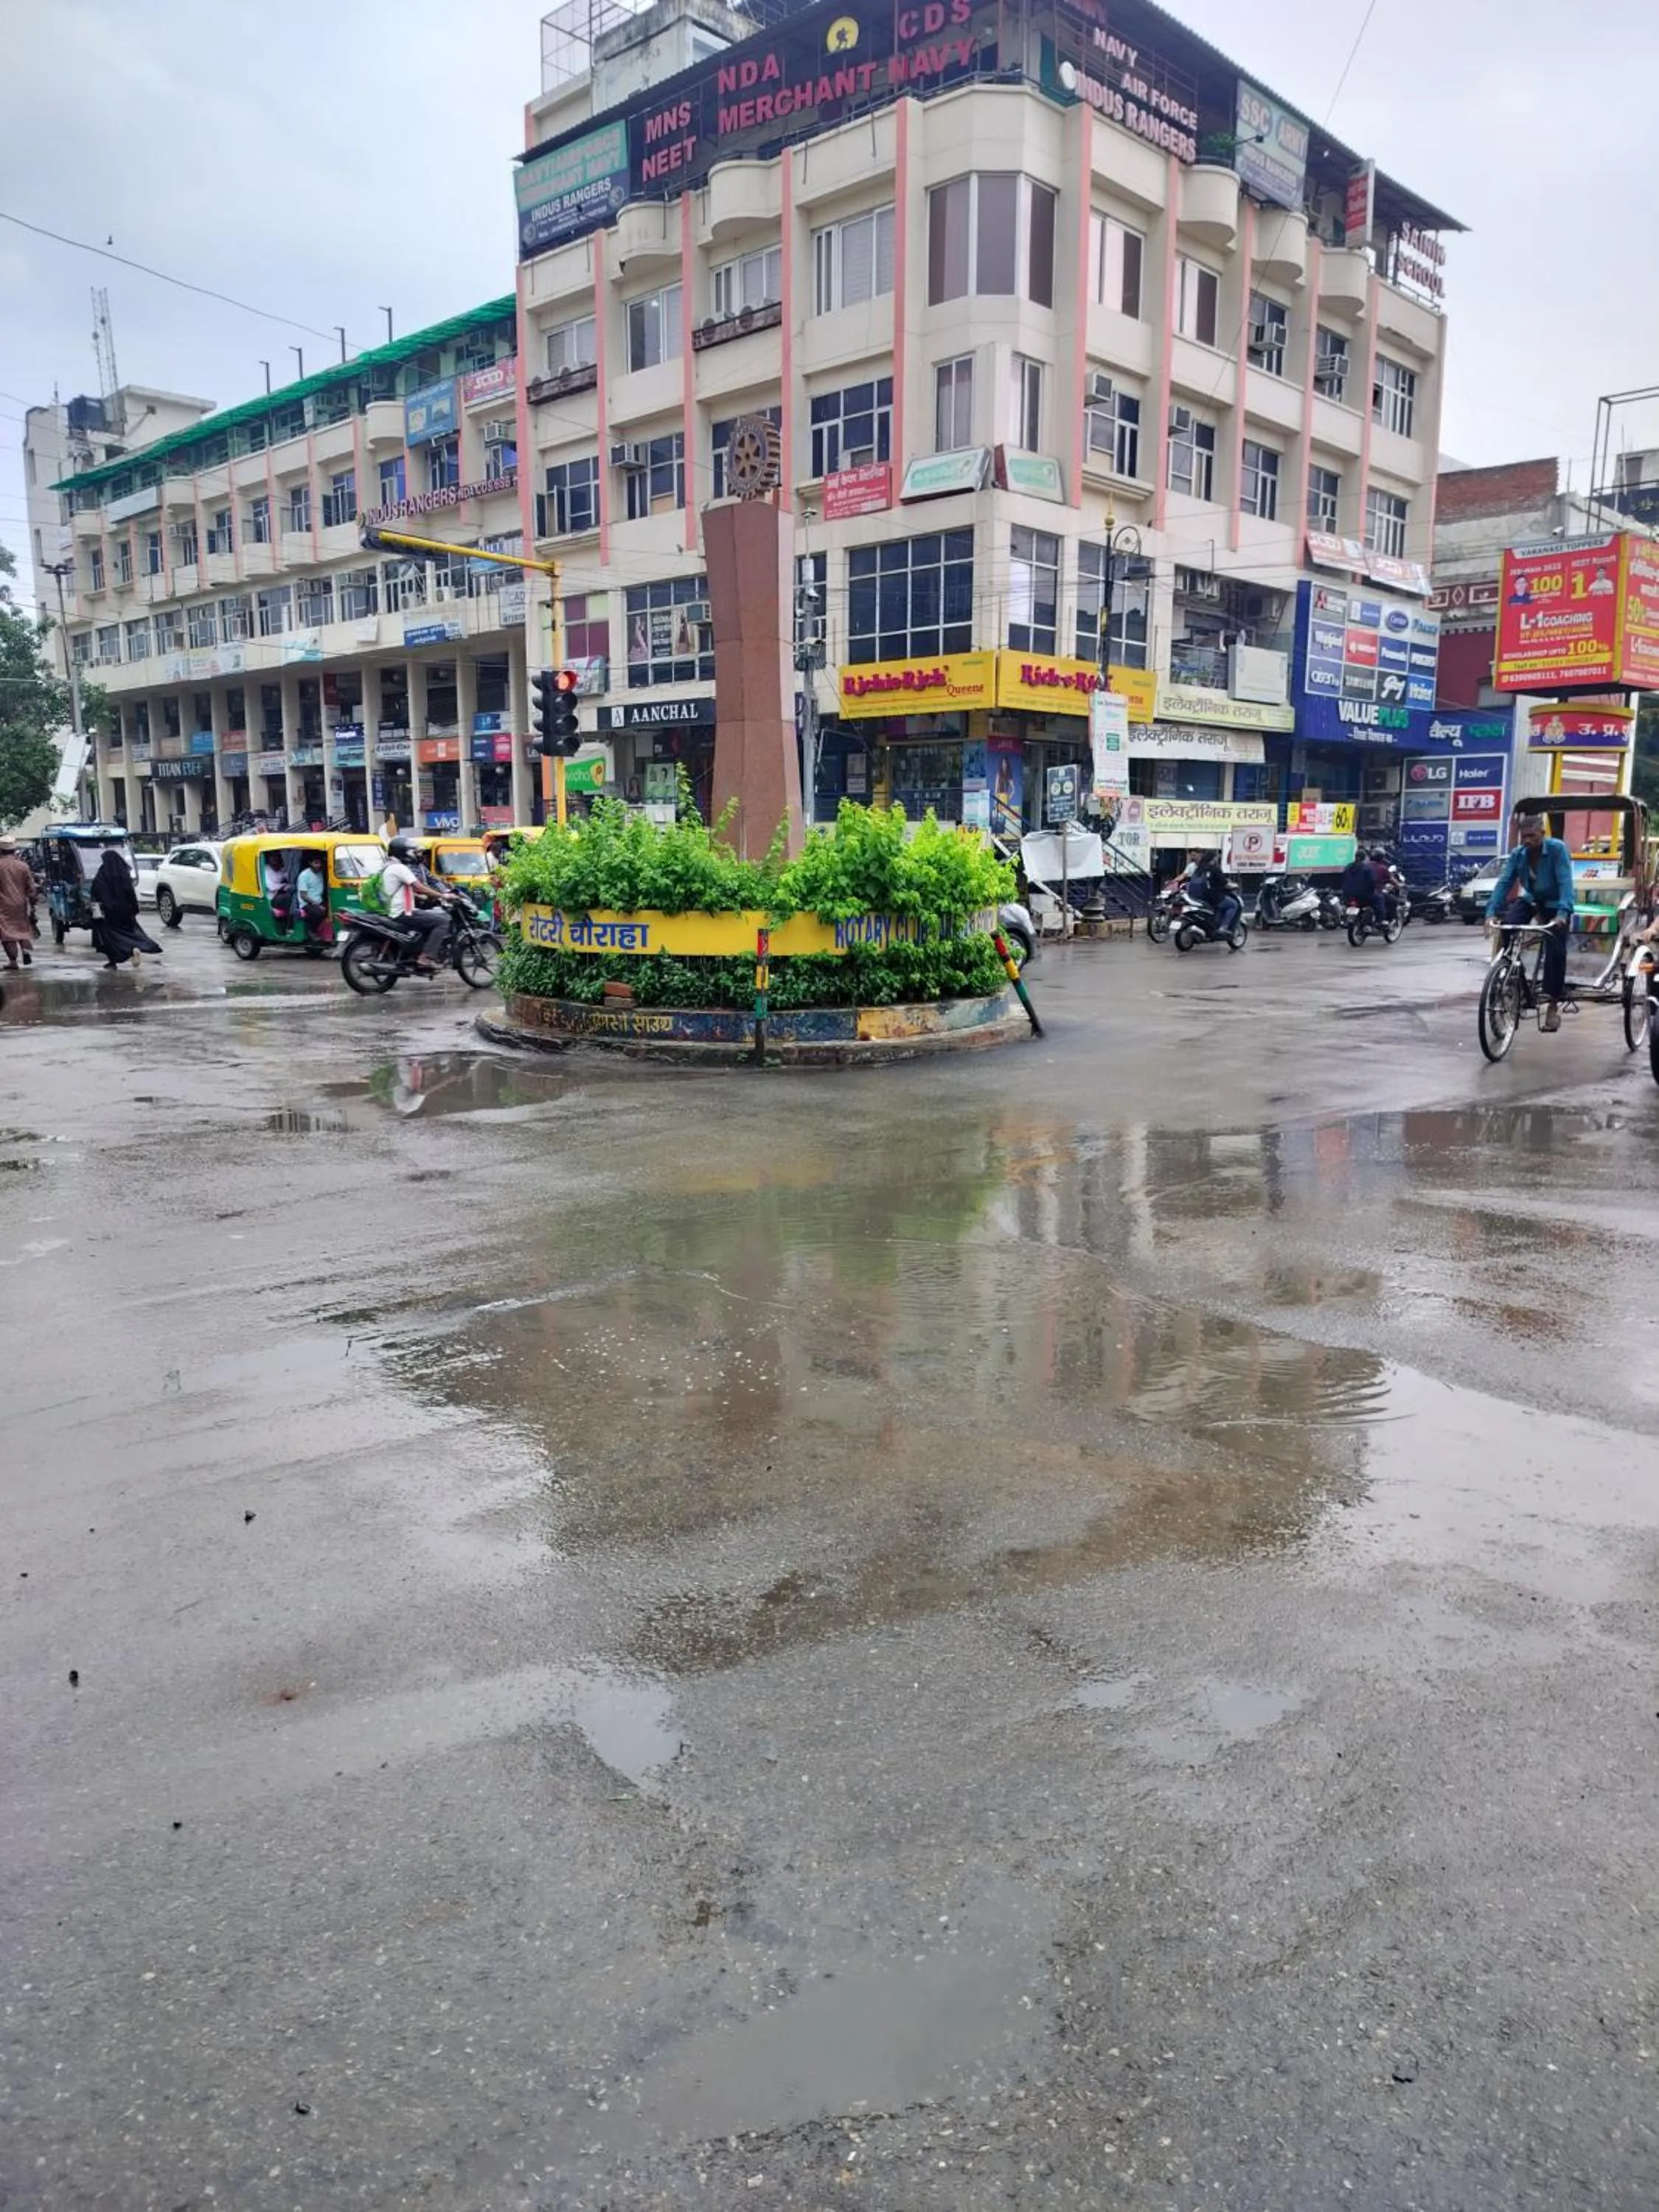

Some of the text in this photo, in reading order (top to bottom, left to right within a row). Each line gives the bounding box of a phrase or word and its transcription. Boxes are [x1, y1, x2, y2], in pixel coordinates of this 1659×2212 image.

[898, 0, 972, 40] CDS
[1093, 27, 1138, 68] NAVY
[718, 53, 781, 94] NDA
[718, 36, 978, 134] MERCHANT NAVY
[1075, 69, 1197, 163] INDUS RANGERS
[1121, 73, 1199, 131] AIR FORCE
[1241, 93, 1271, 136] SSC
[646, 101, 692, 144] MNS
[642, 136, 697, 183] NEET
[531, 198, 561, 222] INDUS
[562, 176, 612, 209] RANGERS
[1397, 251, 1446, 299] SCHOOL
[399, 485, 457, 518] RANGERS
[1530, 575, 1563, 594] 100
[1570, 571, 1587, 599] 1
[630, 703, 698, 724] AANCHAL
[158, 762, 182, 775] TITAN
[1427, 767, 1447, 779] LG
[1458, 769, 1489, 779] Haier
[434, 816, 459, 827] vivo
[1147, 804, 1231, 820] इलेक्ट्रॉनिक
[1457, 794, 1496, 810] IFB
[529, 908, 649, 950] रोटरी चौराहा
[834, 915, 891, 948] ROTARY
